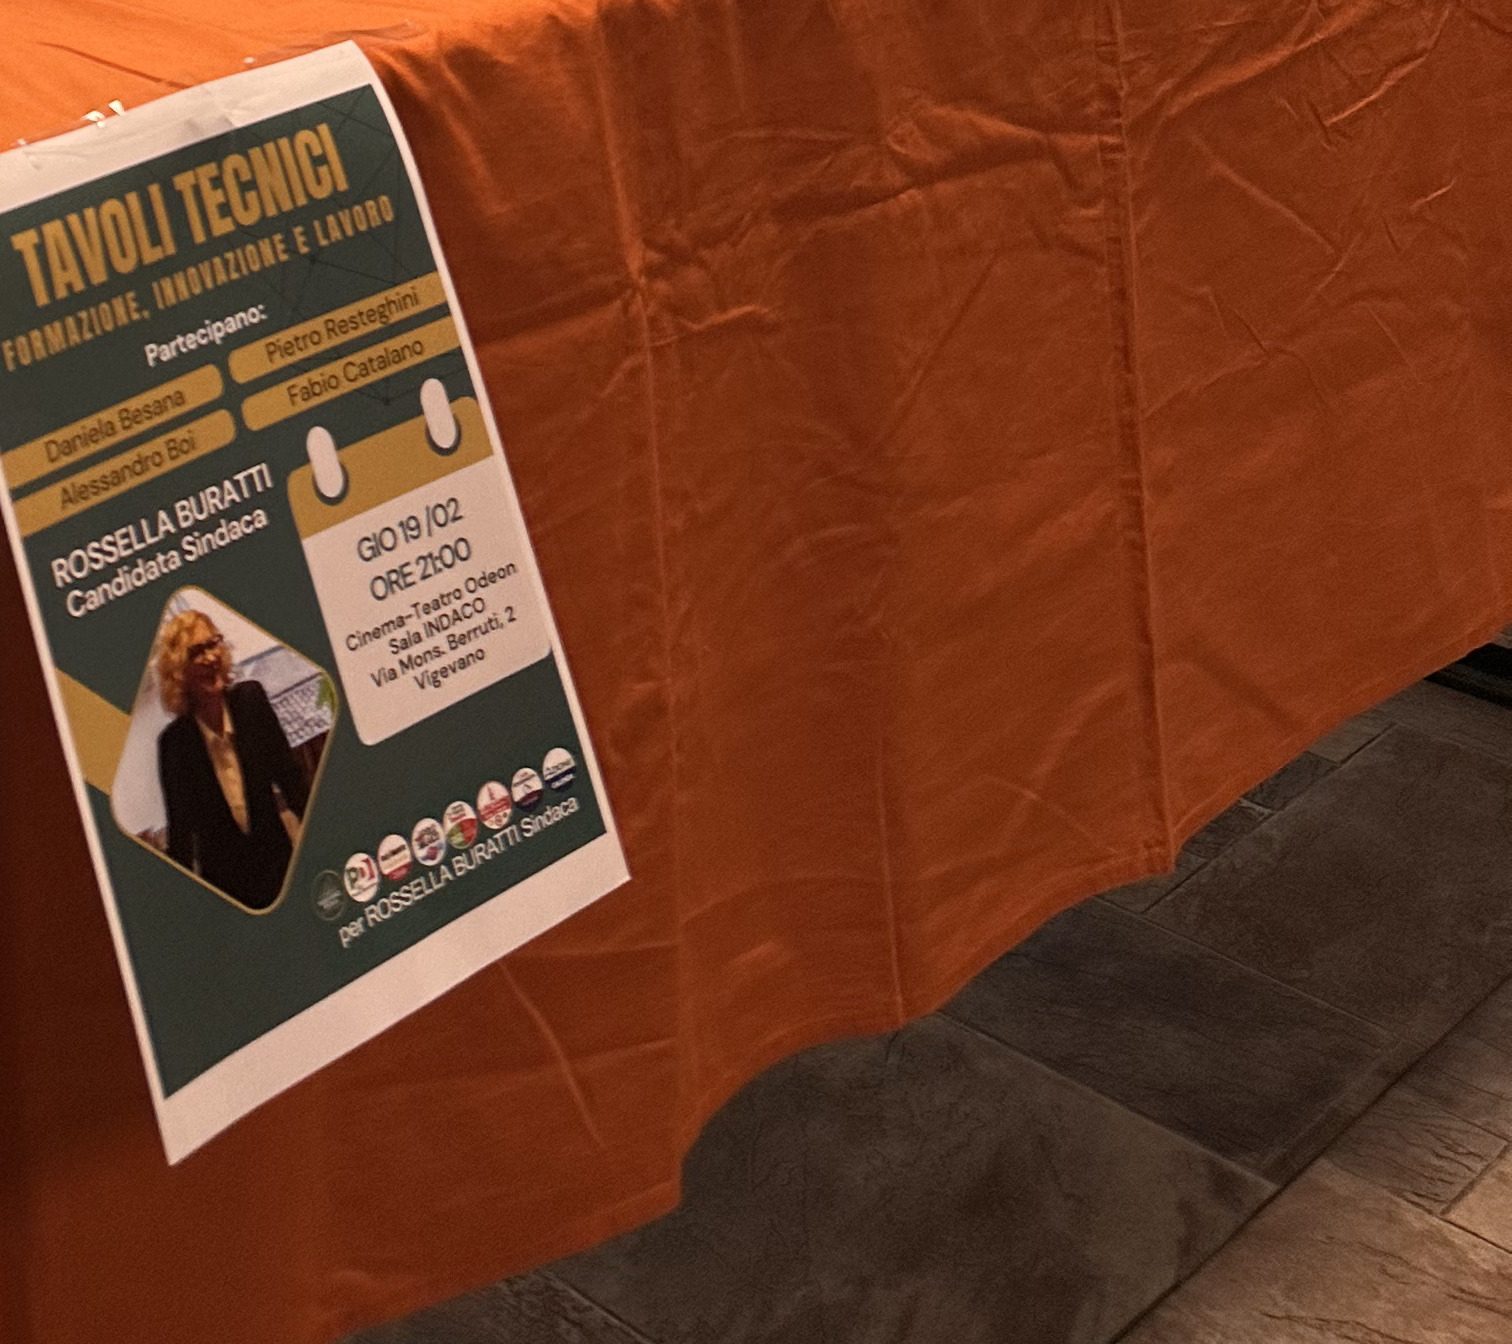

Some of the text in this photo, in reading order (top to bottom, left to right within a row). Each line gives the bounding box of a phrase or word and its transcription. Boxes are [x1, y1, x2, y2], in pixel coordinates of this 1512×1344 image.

[9, 122, 350, 308] TAVOLI TECNICI
[0, 194, 396, 373] FORMAZIONE, INNOVAZIONE E LAVORO
[143, 303, 269, 367] Partecipano:
[264, 286, 421, 364] Pietro Resteghini
[286, 336, 426, 407] Fabio Catalano
[43, 387, 187, 465] Daniela Besana
[59, 433, 198, 511] Alessandro Boi
[49, 462, 274, 589] ROSSELLA BURATTI
[65, 508, 270, 618] Candidata Sindaca
[356, 496, 465, 563] GIO 19 /02
[345, 562, 518, 652] Cinema-Teatro Odeon
[369, 536, 472, 602] ORE 21:00
[369, 605, 518, 688] Via Mons. Berruti, 2
[388, 596, 487, 656] Sala INDACO
[413, 647, 486, 691] Vigevano
[338, 916, 368, 948] per
[364, 863, 456, 929] ROSSELLA
[451, 827, 522, 877] BURATTI
[521, 796, 580, 839] Sindaca
